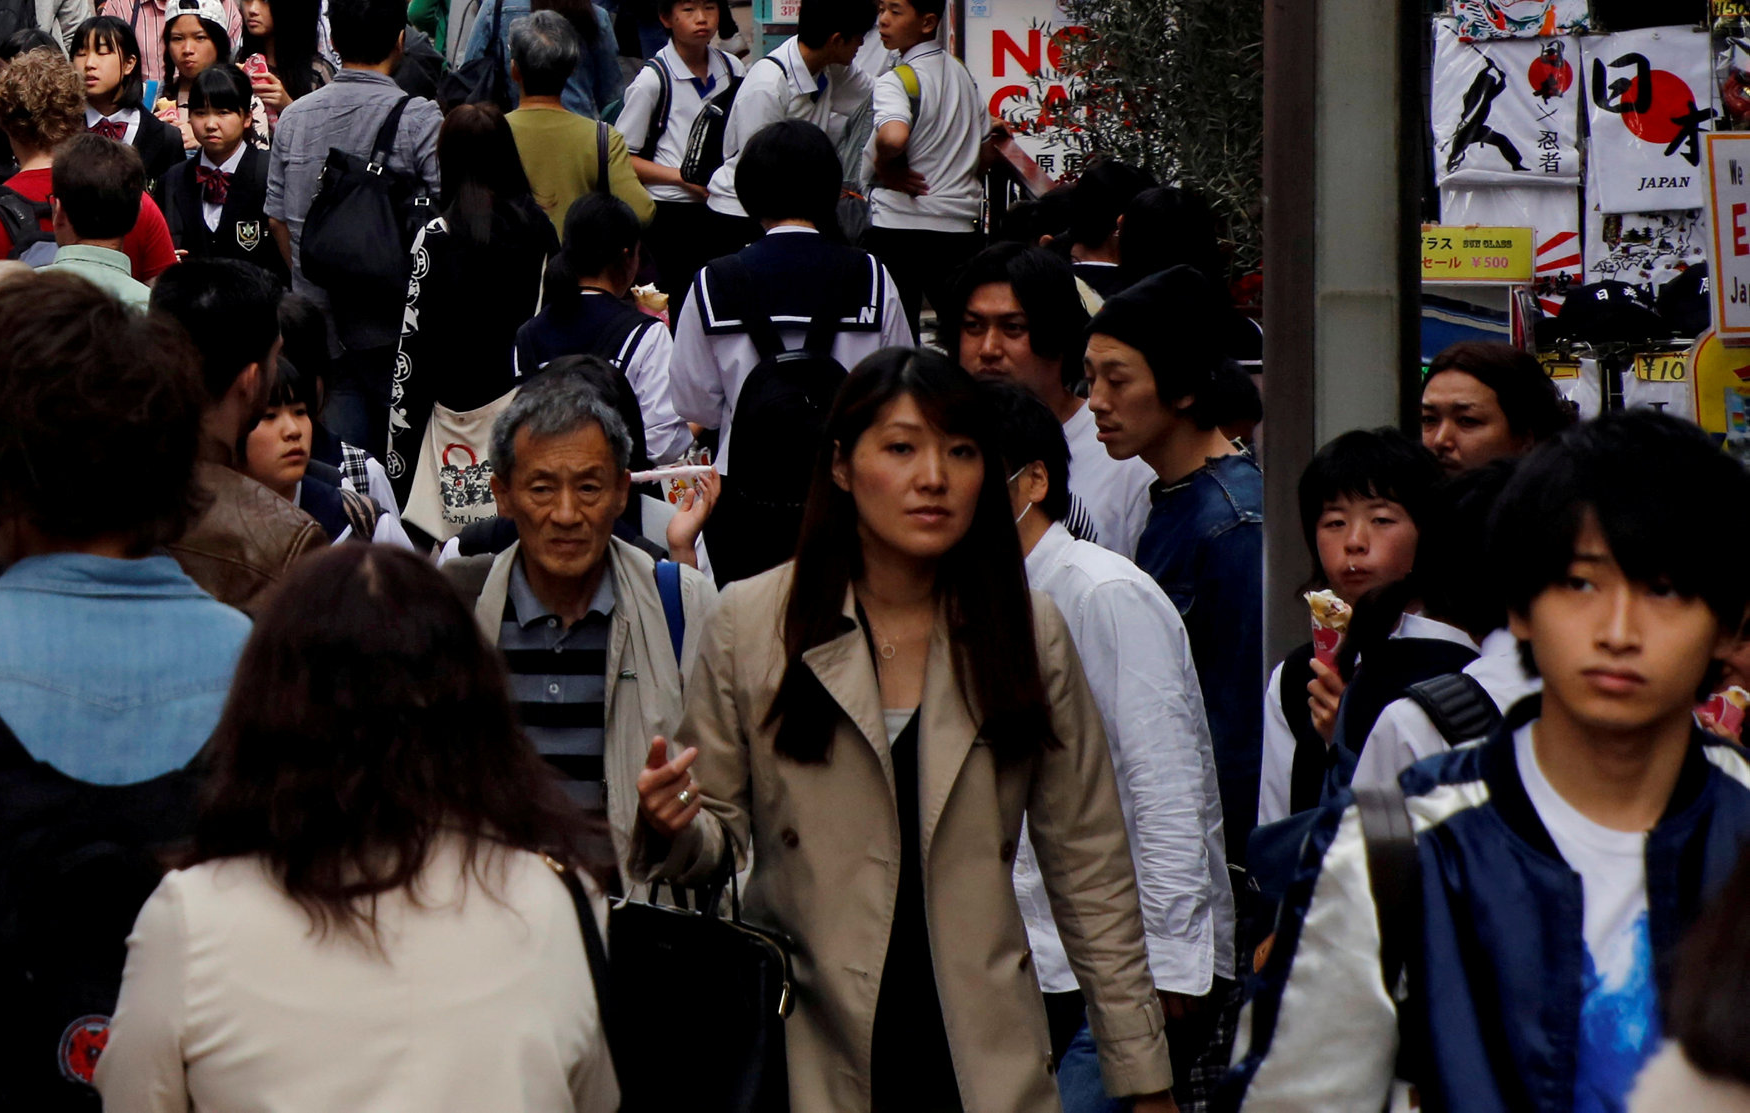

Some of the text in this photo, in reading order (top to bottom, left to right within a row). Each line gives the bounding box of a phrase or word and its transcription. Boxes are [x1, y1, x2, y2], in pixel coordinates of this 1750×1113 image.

[1537, 130, 1562, 174] 忍者
[1638, 177, 1690, 190] JAPAN
[1729, 159, 1743, 185] We
